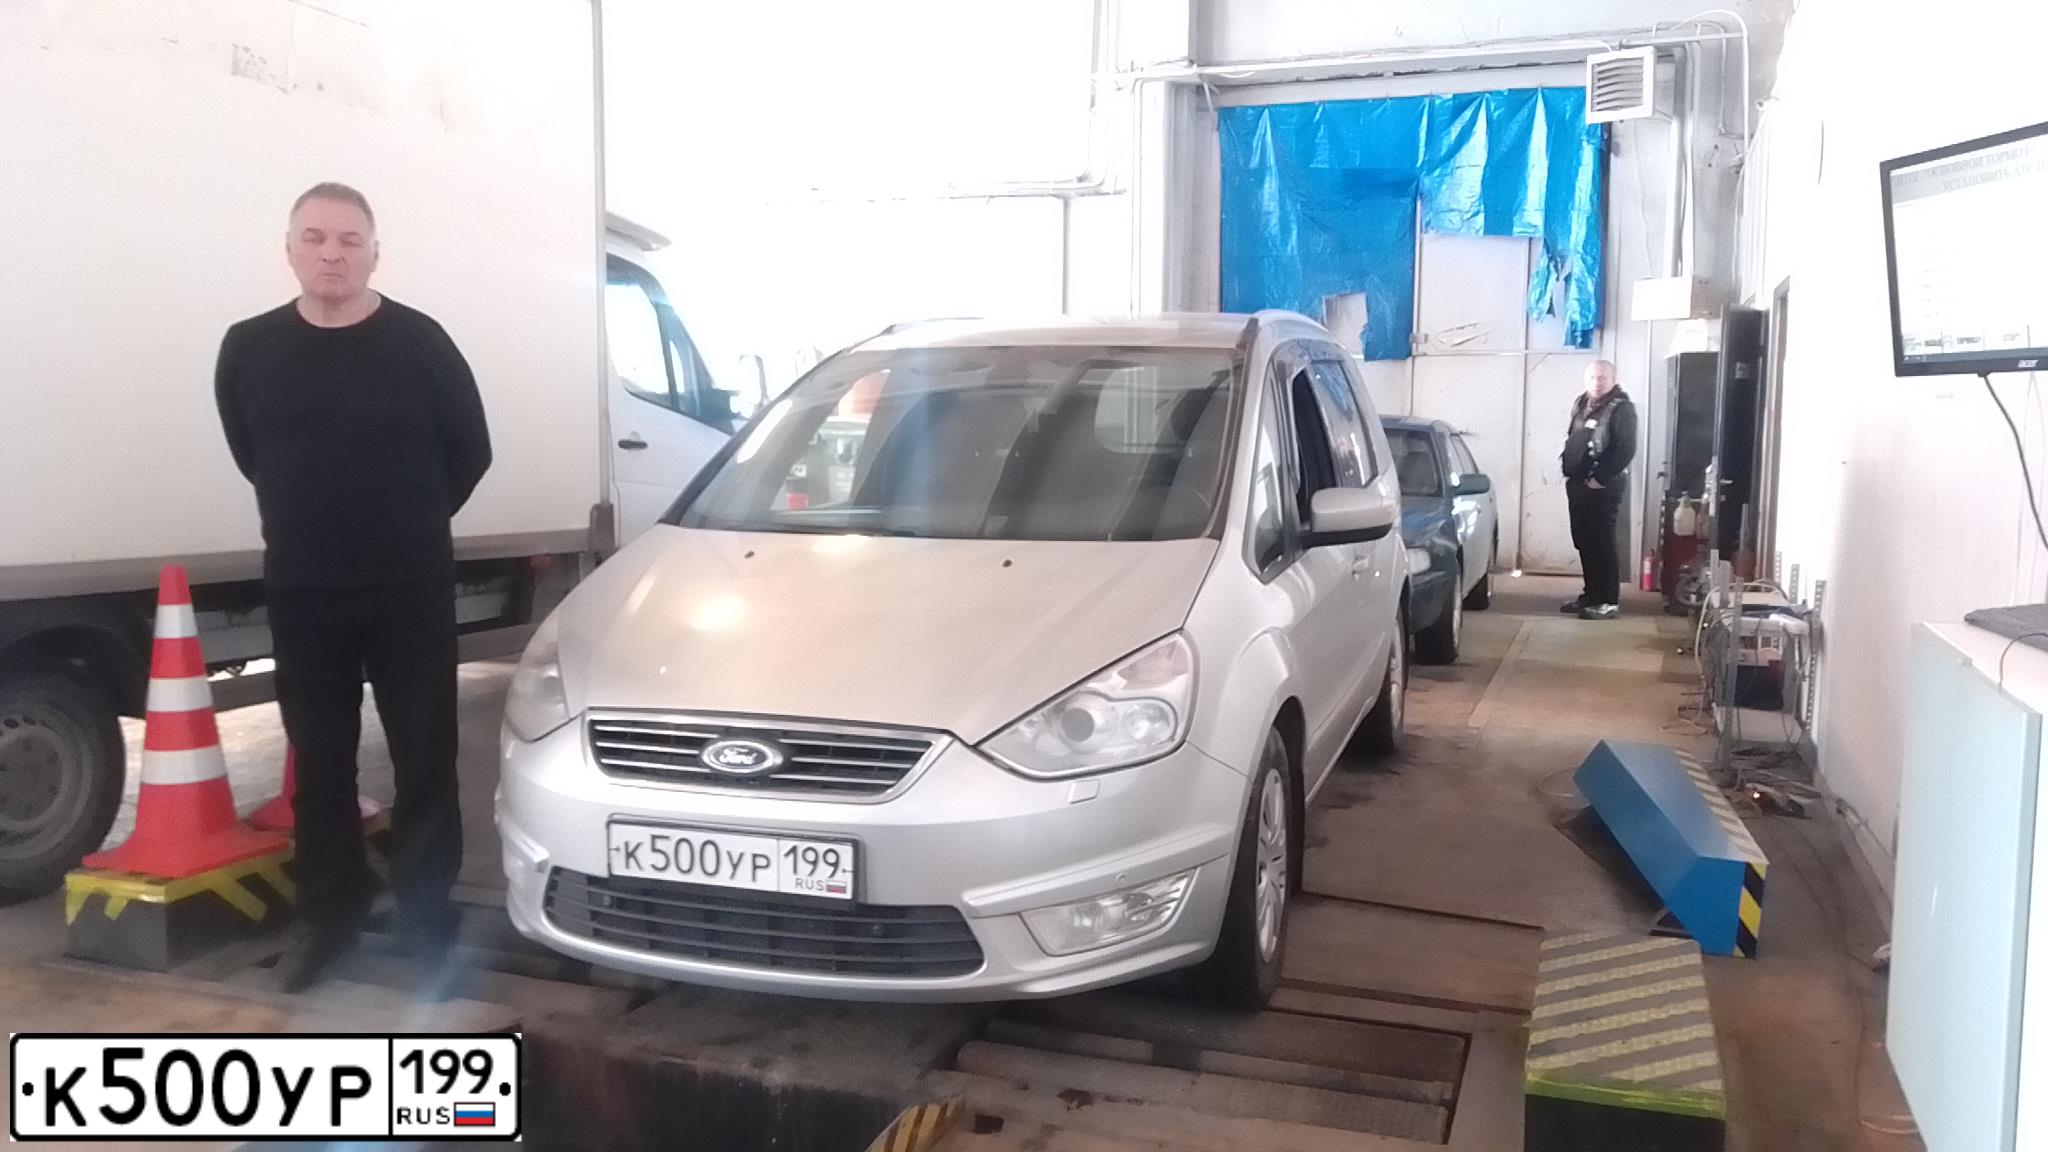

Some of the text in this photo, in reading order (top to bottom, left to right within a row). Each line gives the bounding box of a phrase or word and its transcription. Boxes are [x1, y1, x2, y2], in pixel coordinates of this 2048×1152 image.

[719, 747, 758, 765] Ford
[783, 844, 840, 879] 199
[795, 877, 825, 892] RUS
